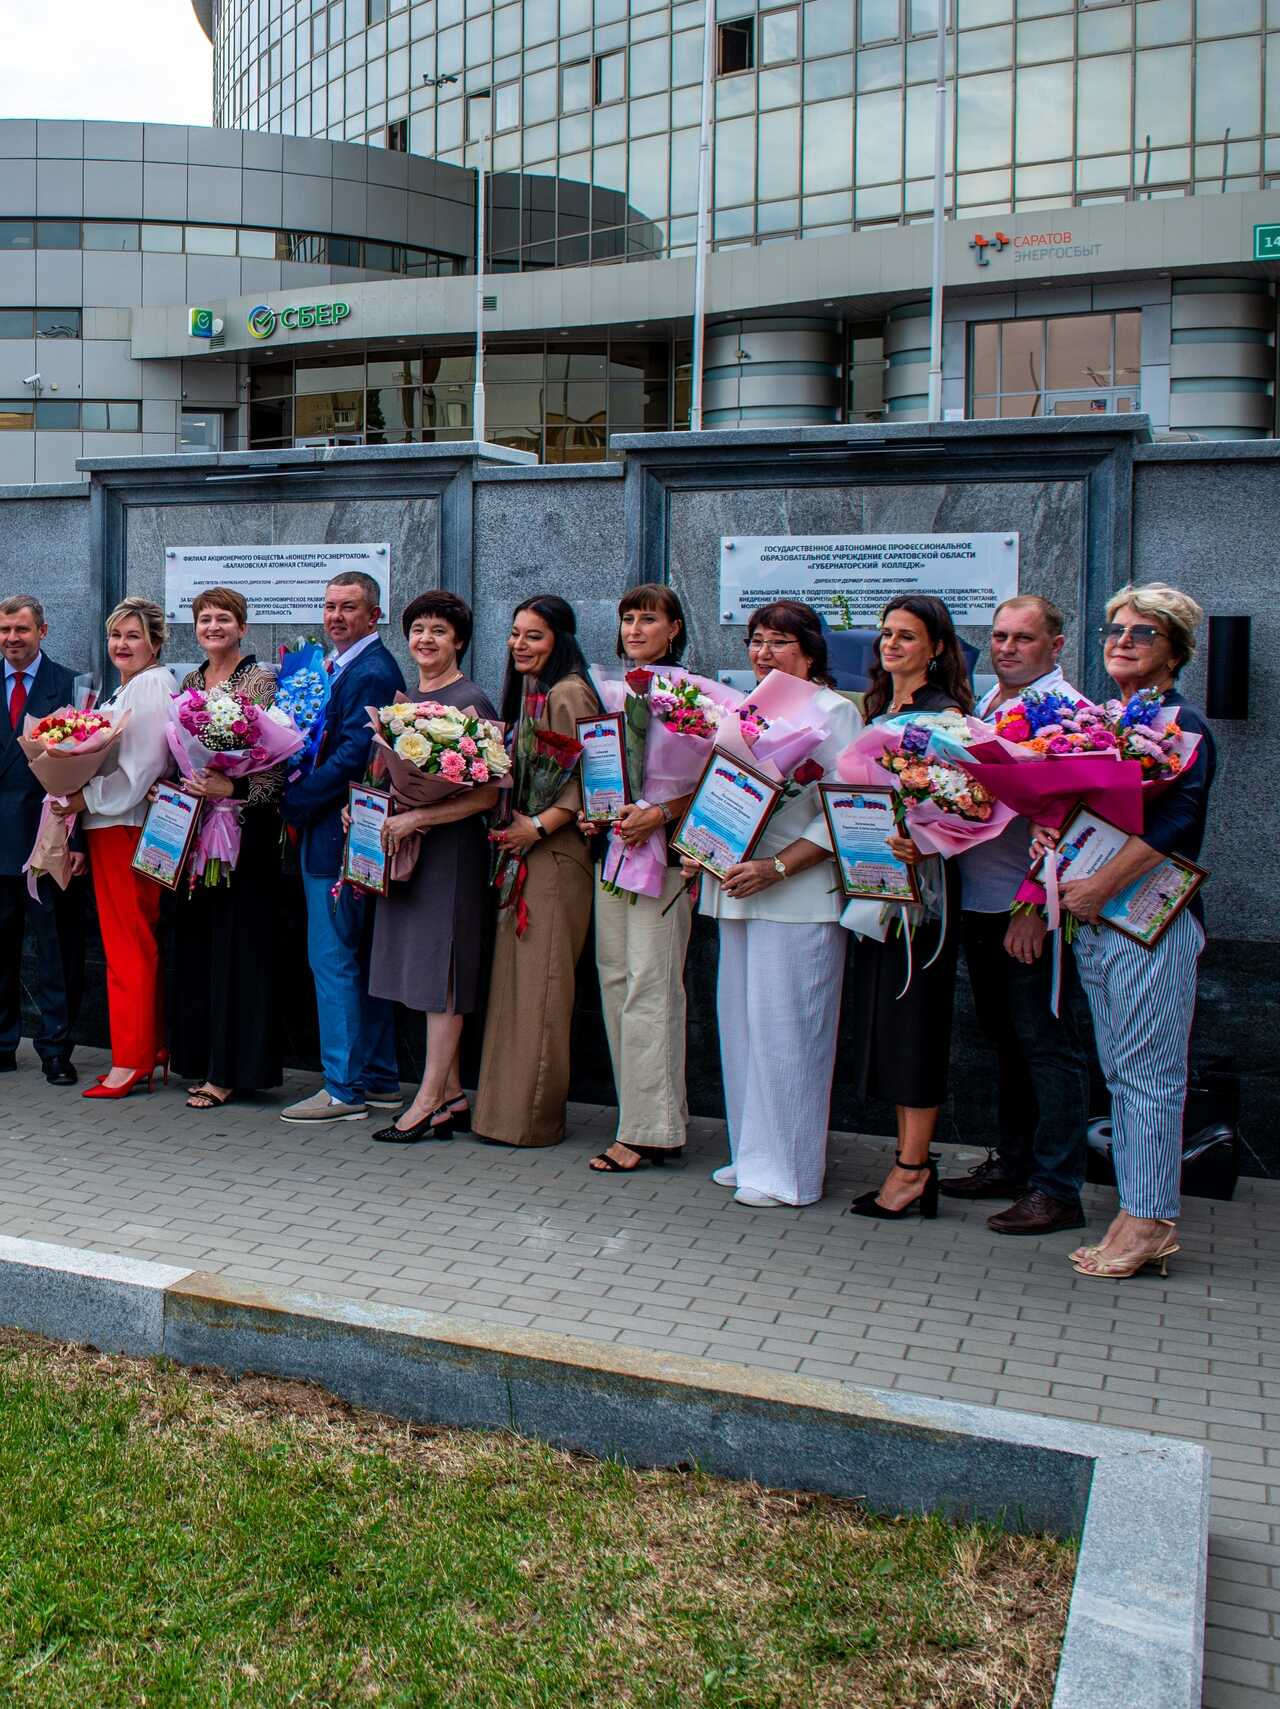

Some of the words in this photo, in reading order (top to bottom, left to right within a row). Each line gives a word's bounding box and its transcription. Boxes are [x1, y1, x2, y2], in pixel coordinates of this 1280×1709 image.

[1014, 231, 1072, 247] САРАТОВ
[1014, 244, 1103, 263] ЭНЕРГОСБЫТ
[280, 302, 350, 329] СБЕР
[764, 545, 833, 553] ГОСУДАРСТВЕННОЕ
[888, 542, 972, 551] ПРОФЕССИОНАЛЬНОЕ
[208, 554, 252, 562] АКЦИОНЕРНОГО
[760, 554, 830, 562] ОБРАЗОВАТЕЛЬНОЕ
[832, 553, 882, 561] УЧРЕЖДЕНИЕ
[883, 552, 938, 560] САРАТОВСКОЙ
[939, 551, 976, 559] ОБЛАСТИ
[807, 561, 878, 570] «ГУБЕРНАТОРСКИЙ
[881, 561, 926, 569] КОЛЛЕДЖ»
